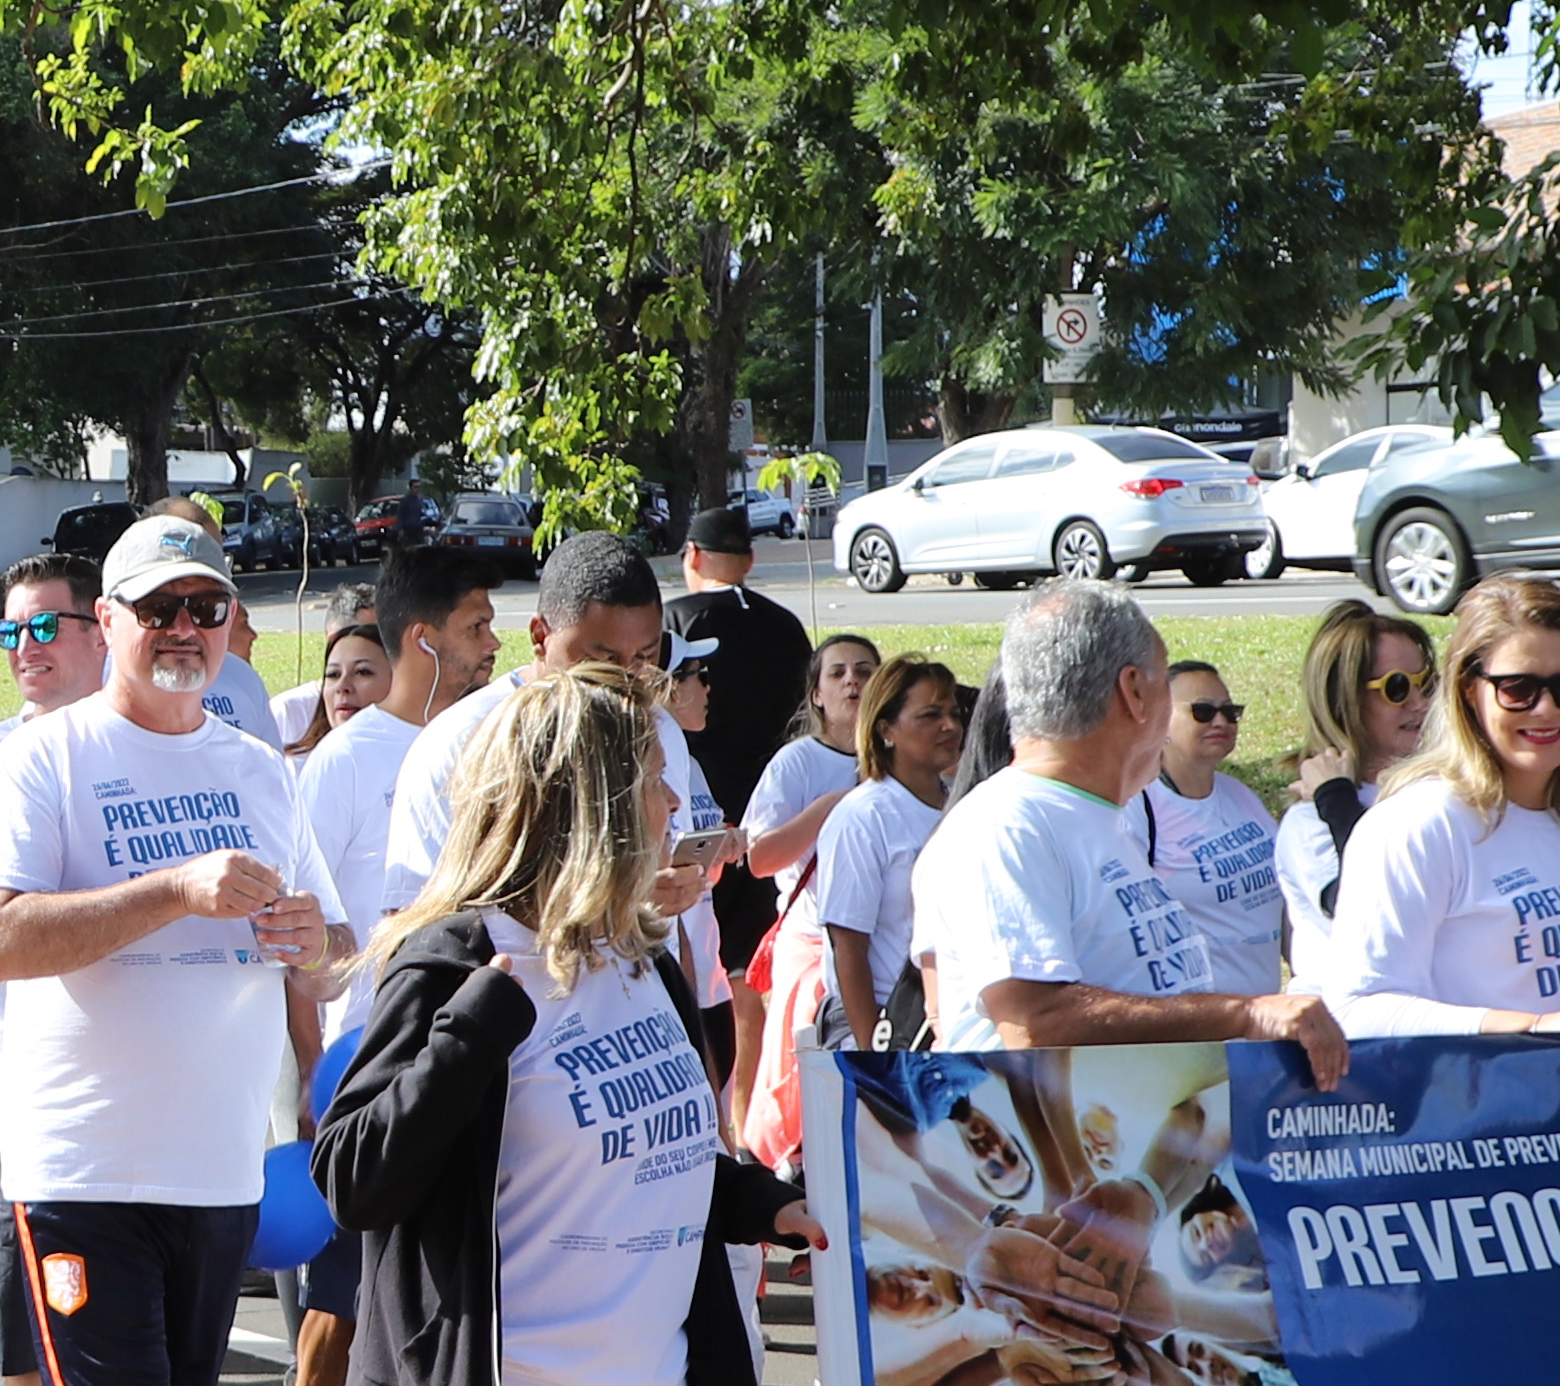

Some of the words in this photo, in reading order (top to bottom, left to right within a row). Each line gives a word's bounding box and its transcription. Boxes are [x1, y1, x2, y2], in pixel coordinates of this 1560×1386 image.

[102, 787, 241, 832] PREVENÇÃO
[104, 834, 124, 867] É
[127, 823, 258, 864] QUALIDADE
[1216, 880, 1238, 903] DE
[1240, 865, 1276, 894] VIDA
[1129, 920, 1148, 957] É
[1514, 928, 1533, 964] É
[568, 1084, 597, 1128] É
[1267, 1103, 1396, 1140] CAMINHADA:
[601, 1124, 637, 1165] DE
[644, 1099, 702, 1150] VIDA
[655, 1153, 668, 1167] DO
[668, 1147, 686, 1162] SEU
[1268, 1146, 1358, 1183] SEMANA
[1361, 1141, 1474, 1177] MUNICIPAL
[1478, 1140, 1505, 1168] DE
[634, 1168, 675, 1185] ESCOLHA
